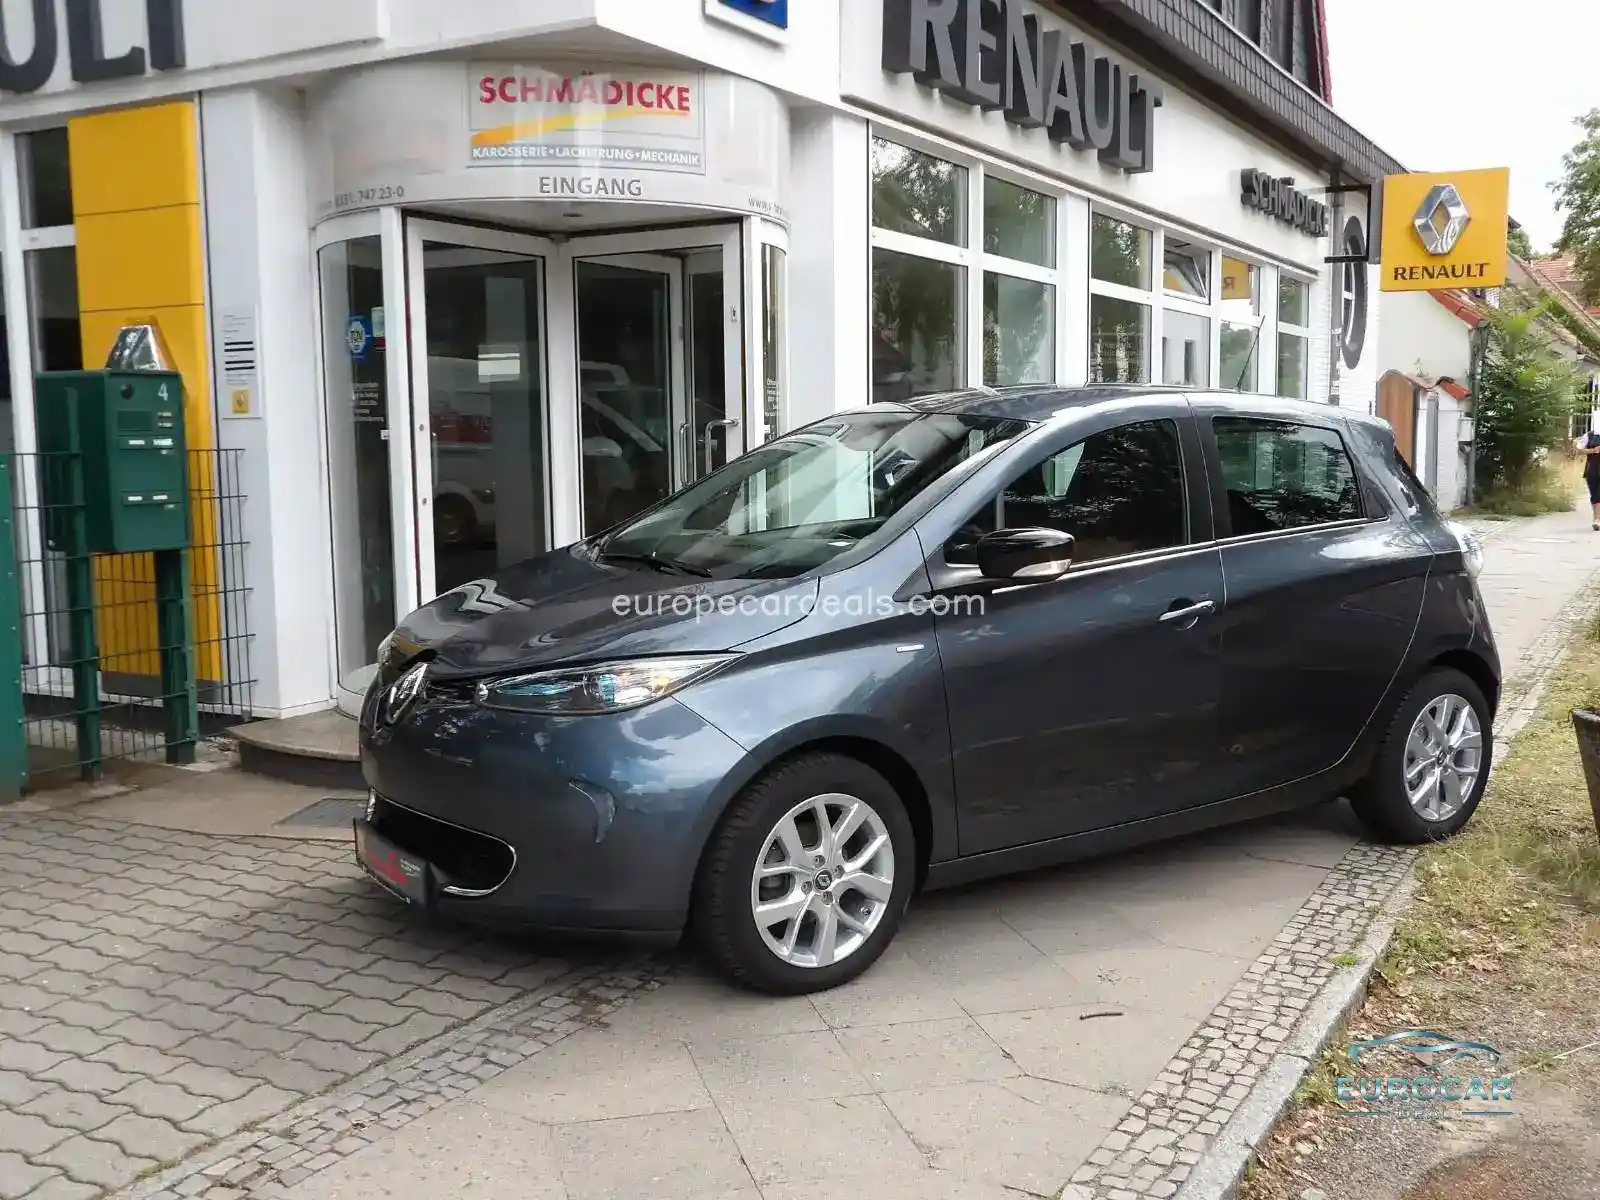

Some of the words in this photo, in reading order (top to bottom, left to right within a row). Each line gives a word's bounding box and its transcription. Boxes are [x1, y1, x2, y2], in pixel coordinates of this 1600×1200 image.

[479, 70, 691, 111] SCHMÄDICKE
[472, 145, 548, 160] KAROSSERIE
[640, 151, 700, 166] MECHANIK
[538, 175, 643, 197] EINGANG
[1392, 262, 1491, 282] RENAULT
[157, 382, 169, 401] 4
